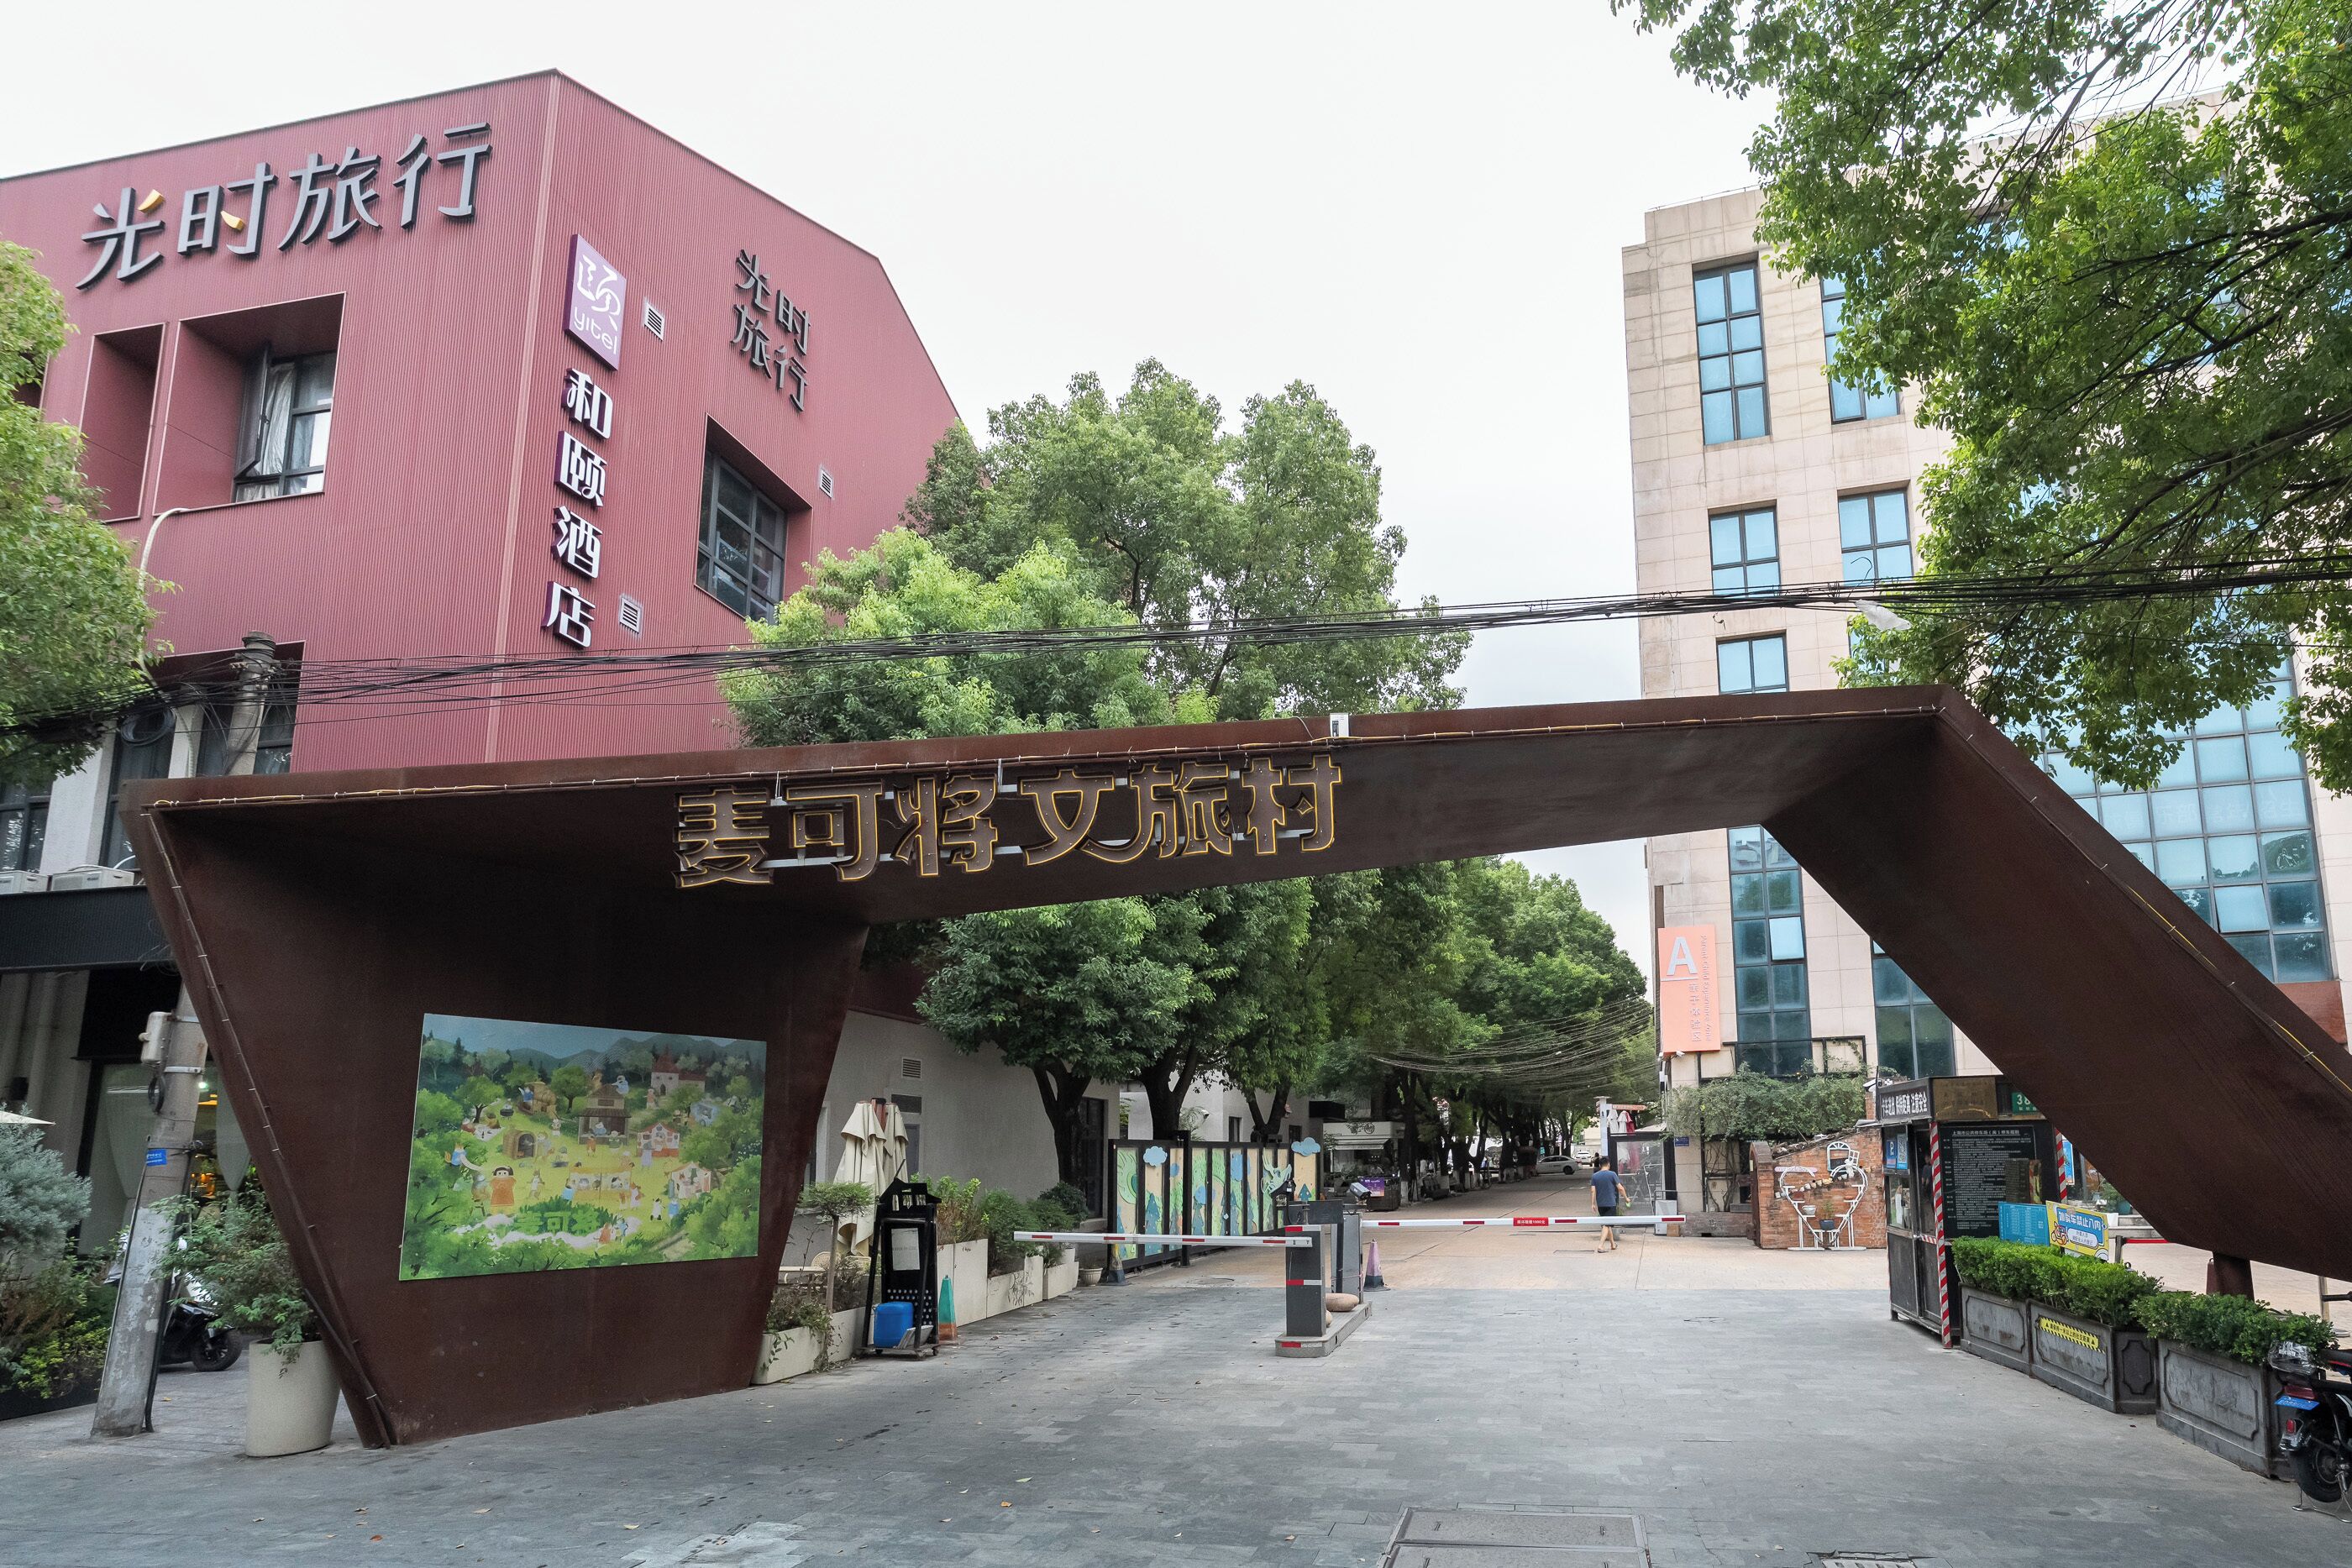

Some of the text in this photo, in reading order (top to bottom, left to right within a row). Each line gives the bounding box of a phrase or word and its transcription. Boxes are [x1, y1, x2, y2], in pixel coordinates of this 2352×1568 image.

[76, 122, 493, 290] 光时旅行
[573, 307, 617, 355] yitel
[736, 249, 811, 356] 光时
[730, 303, 808, 412] 旅行
[543, 368, 613, 648] 和颐酒店
[674, 753, 1344, 889] 麦可将文旅村
[1667, 936, 1698, 976] A
[1896, 1093, 1911, 1115] 保持距离
[1911, 1091, 1928, 1114] 注意安全
